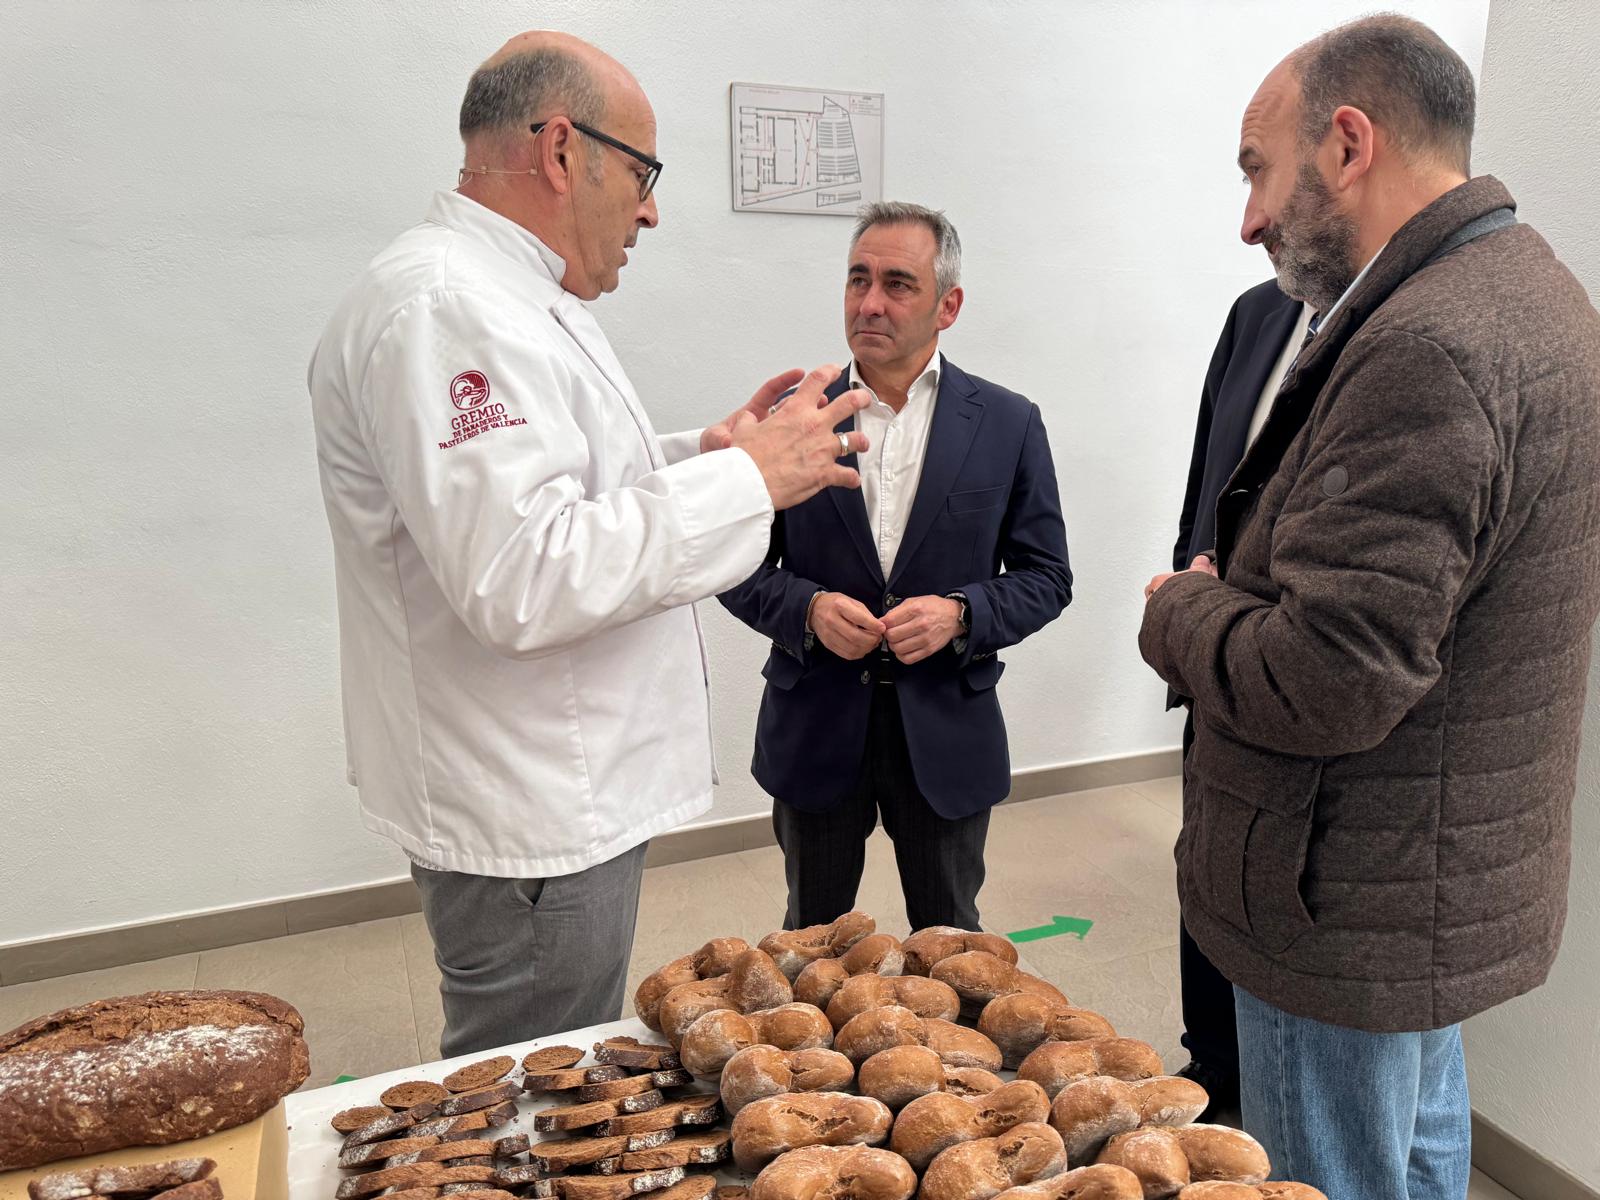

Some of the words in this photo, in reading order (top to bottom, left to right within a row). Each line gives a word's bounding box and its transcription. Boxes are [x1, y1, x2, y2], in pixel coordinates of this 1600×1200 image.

[451, 403, 505, 430] GREMIO
[452, 430, 462, 438] DE
[462, 415, 501, 431] PANADEROS
[438, 429, 480, 449] PASTELEROS
[481, 425, 490, 433] DE
[490, 418, 528, 429] VALENCIA
